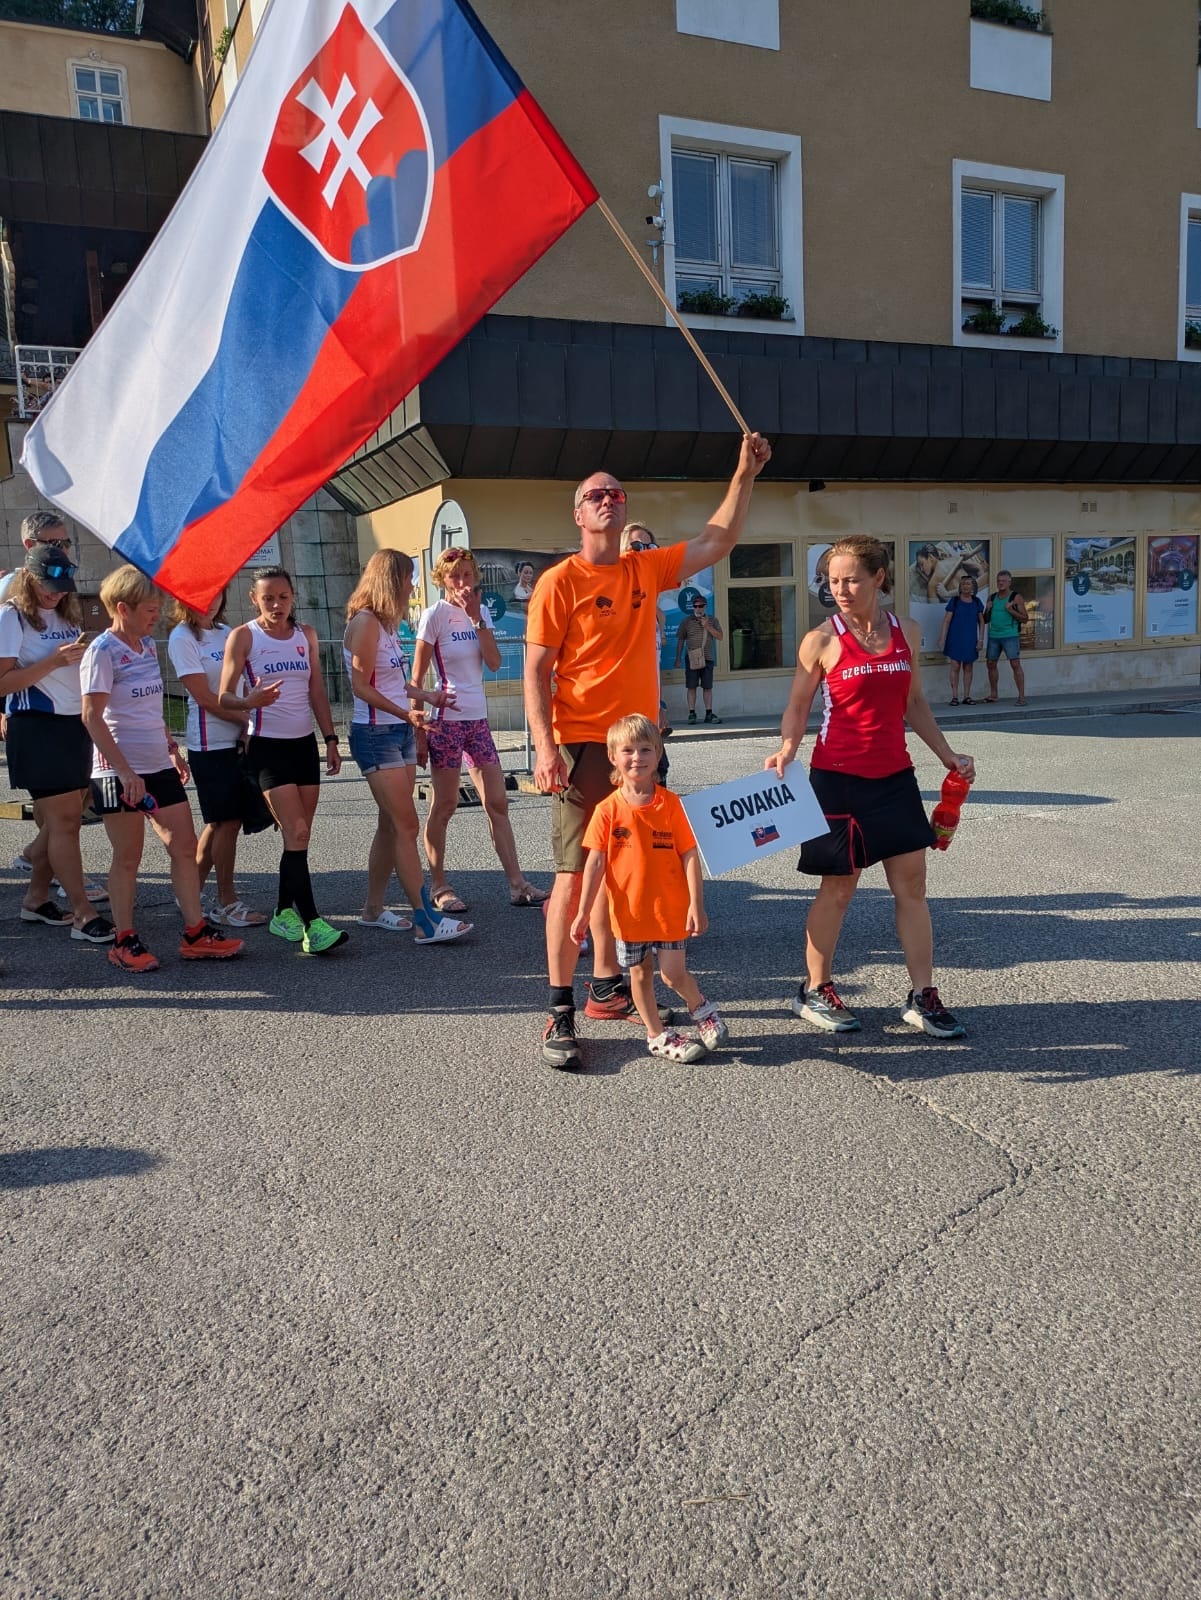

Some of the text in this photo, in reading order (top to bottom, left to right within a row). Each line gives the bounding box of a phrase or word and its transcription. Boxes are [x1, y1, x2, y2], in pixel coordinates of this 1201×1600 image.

[263, 661, 309, 674] SLOVAKIA
[842, 659, 911, 681] czech republi
[710, 783, 796, 828] SLOVAKIA
